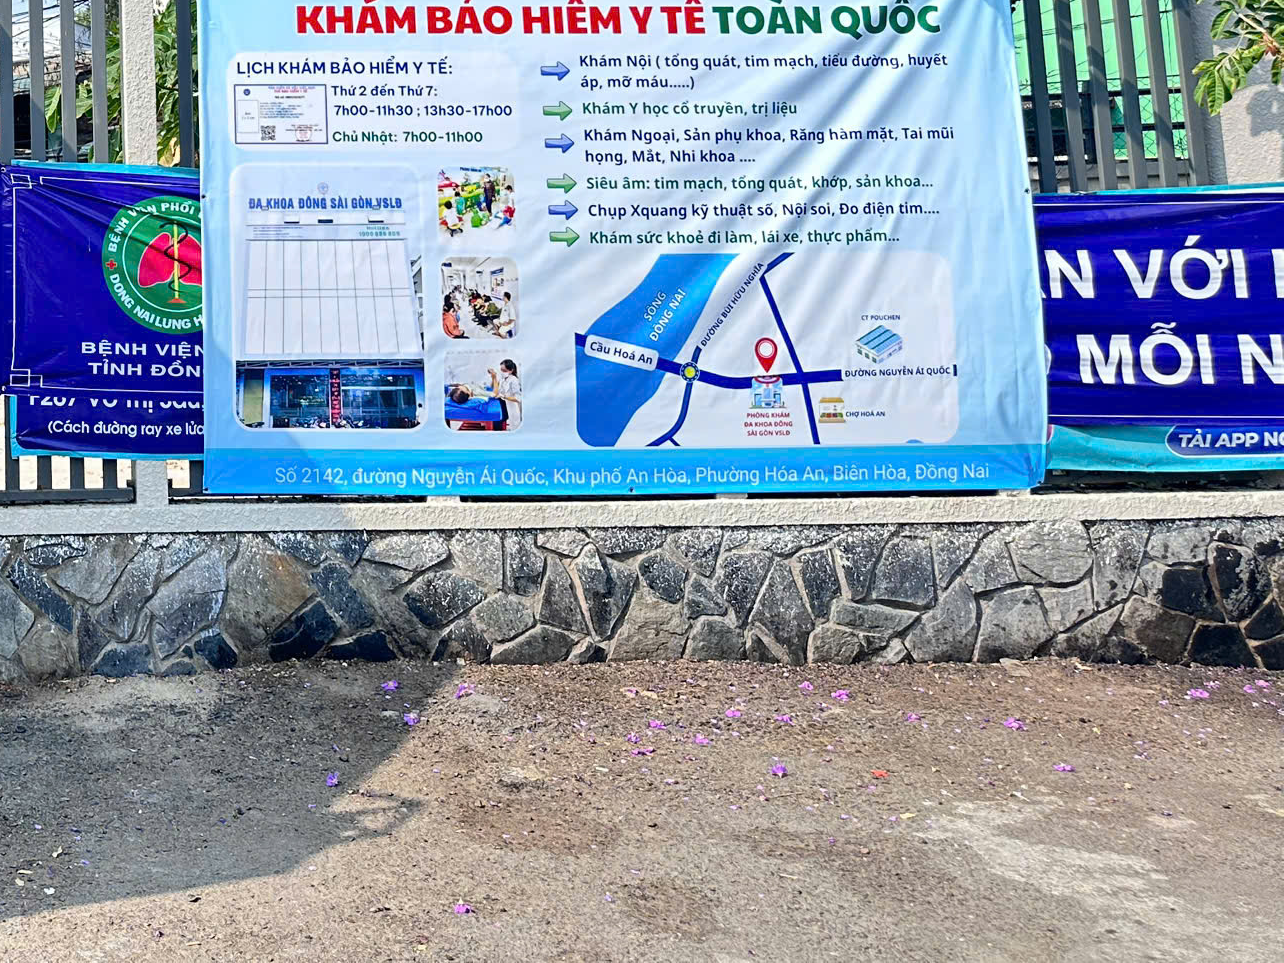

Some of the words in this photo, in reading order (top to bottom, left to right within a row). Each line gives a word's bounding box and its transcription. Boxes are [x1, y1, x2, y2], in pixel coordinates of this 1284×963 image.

[628, 6, 653, 34] Y
[237, 62, 274, 78] LỊCH
[278, 58, 326, 74] KHÁM
[330, 58, 365, 74] BẢO
[369, 55, 408, 74] HIỂM
[413, 62, 423, 74] Y
[427, 55, 453, 74] TẾ:
[580, 55, 622, 67] Khám
[627, 55, 651, 70] Nội
[665, 53, 698, 70] tổng
[703, 55, 741, 70] quát,
[745, 55, 769, 67] tim
[774, 55, 818, 69] mạch,
[822, 53, 848, 67] tiểu
[851, 54, 904, 69] đường,
[908, 53, 948, 68] huyết
[331, 85, 357, 96] Thứ
[359, 85, 367, 96] 2
[370, 85, 395, 97] đến
[399, 85, 424, 96] Thứ
[426, 85, 438, 97] 7:
[580, 76, 603, 90] áp,
[607, 76, 632, 88] mỡ
[334, 105, 413, 116] 7h00-11h30
[424, 105, 512, 116] 13h30-17h00
[332, 130, 358, 142] Chủ
[361, 131, 398, 145] Nhật:
[402, 131, 483, 143] 7h00-11h00
[584, 129, 627, 141] Khám
[631, 129, 680, 144] Ngoại,
[684, 128, 710, 141] Sản
[715, 129, 742, 144] phụ
[746, 128, 786, 142] khoa,
[790, 129, 825, 144] Răng
[829, 128, 863, 141] hàm
[866, 127, 898, 143] mặt,
[901, 127, 923, 139] Tai
[927, 127, 954, 139] mũi
[585, 150, 628, 165] họng,
[632, 149, 666, 164] Mắt,
[670, 149, 696, 162] Nhi
[700, 149, 735, 162] khoa
[586, 177, 618, 189] Siêu
[622, 177, 650, 189] âm:
[654, 177, 678, 189] tim
[683, 176, 727, 192] mạch,
[731, 175, 765, 192] tổng
[769, 176, 807, 192] quát,
[811, 175, 852, 191] khớp,
[856, 173, 881, 187] sản
[885, 175, 933, 187] khoa...
[588, 204, 627, 220] Chụp
[631, 204, 687, 220] Xquang
[691, 203, 709, 220] kỹ
[713, 203, 753, 219] thuật
[757, 202, 778, 217] số,
[782, 202, 807, 218] Nội
[811, 203, 835, 216] soi,
[839, 203, 858, 215] Đo
[863, 202, 894, 218] điện
[1113, 235, 1249, 299] VỚI
[81, 339, 147, 357] BỆNH
[589, 340, 611, 355] Cầu
[613, 346, 635, 361] Hoá
[637, 353, 653, 365] An
[1076, 322, 1214, 385] MỖI
[87, 359, 142, 376] TỈNH
[150, 360, 203, 378] ĐỒN
[844, 369, 877, 377] ĐƯỜNG
[879, 366, 913, 376] NGUYỄN
[916, 367, 925, 376] ÁI
[926, 366, 951, 376] QUỐC
[47, 420, 89, 434] (Cách
[93, 420, 137, 437] đường
[141, 425, 162, 437] ray
[166, 425, 182, 435] xe
[1179, 428, 1212, 447] TẢI
[1215, 432, 1259, 447] APP
[275, 467, 297, 483] Số
[301, 468, 348, 485] 2142,
[352, 468, 407, 487] đường
[412, 467, 475, 487] Nguyễn
[480, 465, 497, 483] Ái
[501, 467, 549, 486] Quốc,
[553, 468, 586, 484] Khu
[590, 465, 622, 487] phố
[627, 467, 648, 483] An
[653, 466, 690, 485] Hòa,
[696, 466, 760, 486] Phường
[766, 465, 797, 482] Hóa
[802, 466, 828, 484] An,
[833, 465, 867, 481] Biên
[874, 465, 910, 483] Hòa,
[916, 464, 957, 484] Đồng
[963, 463, 989, 479] Nai
